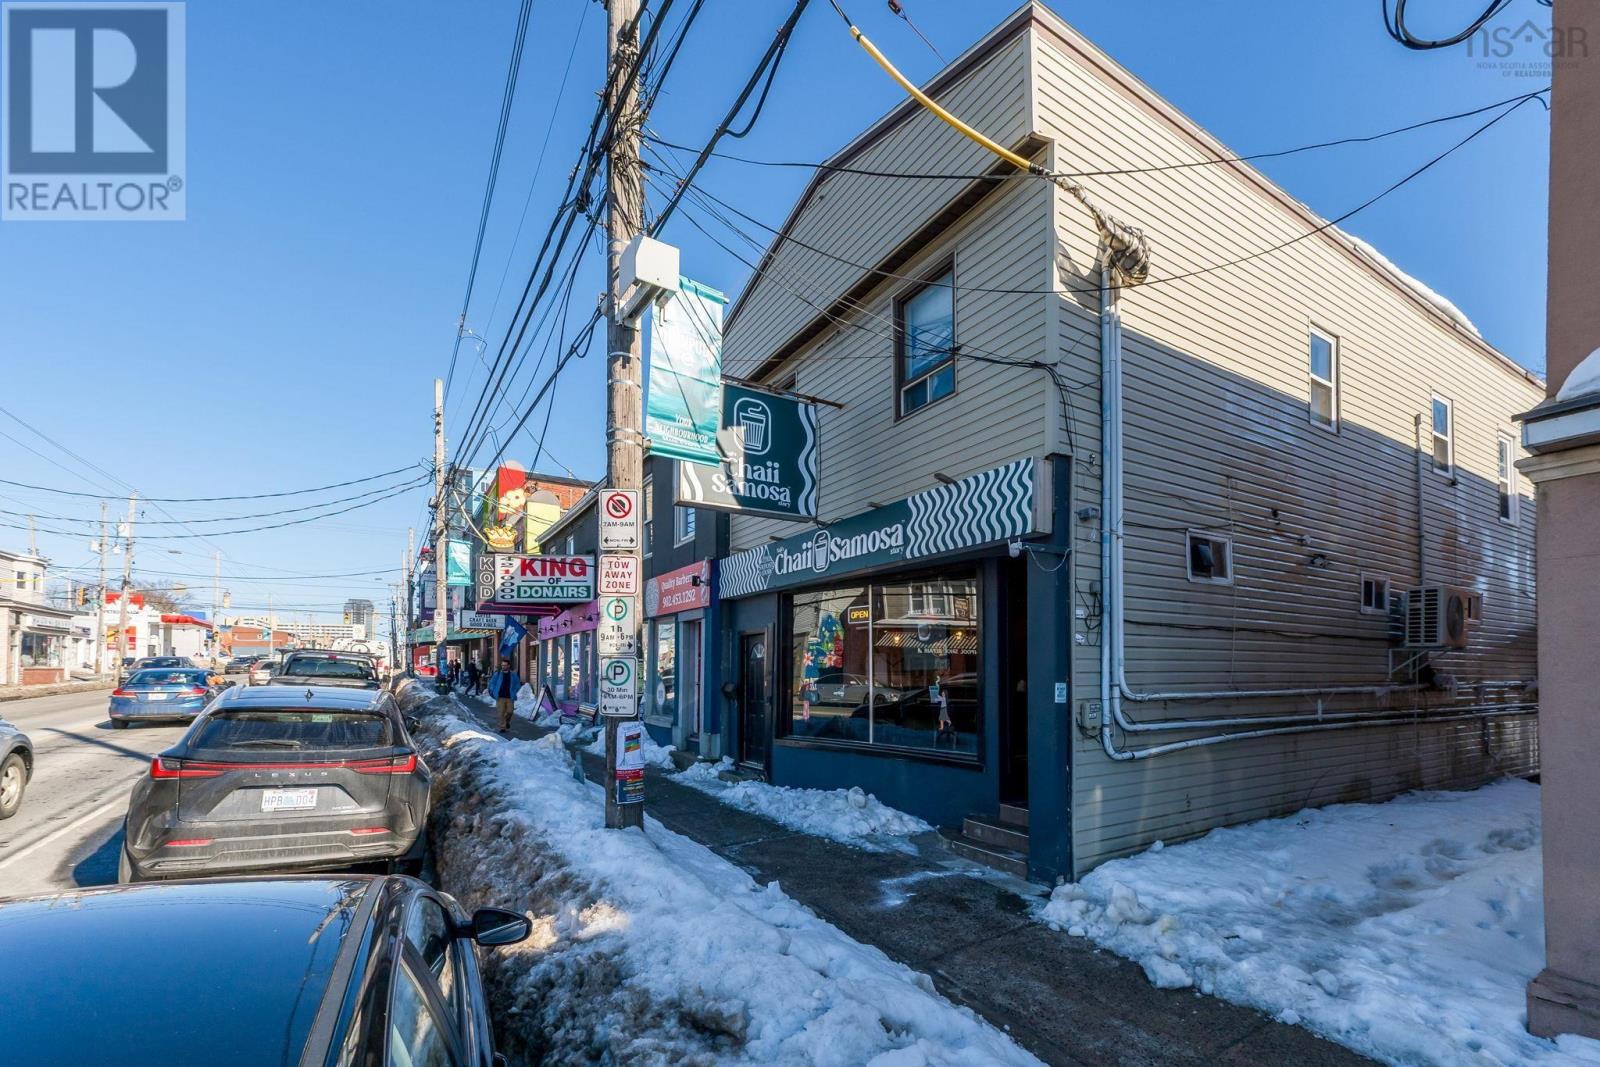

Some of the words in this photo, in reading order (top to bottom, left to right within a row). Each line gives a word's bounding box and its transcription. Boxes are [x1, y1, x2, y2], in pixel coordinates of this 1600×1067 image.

[774, 540, 813, 575] Chaii
[830, 523, 905, 562] Samosa
[520, 557, 587, 577] KING
[520, 586, 588, 598] DONAIRS
[851, 610, 869, 620] OPEN
